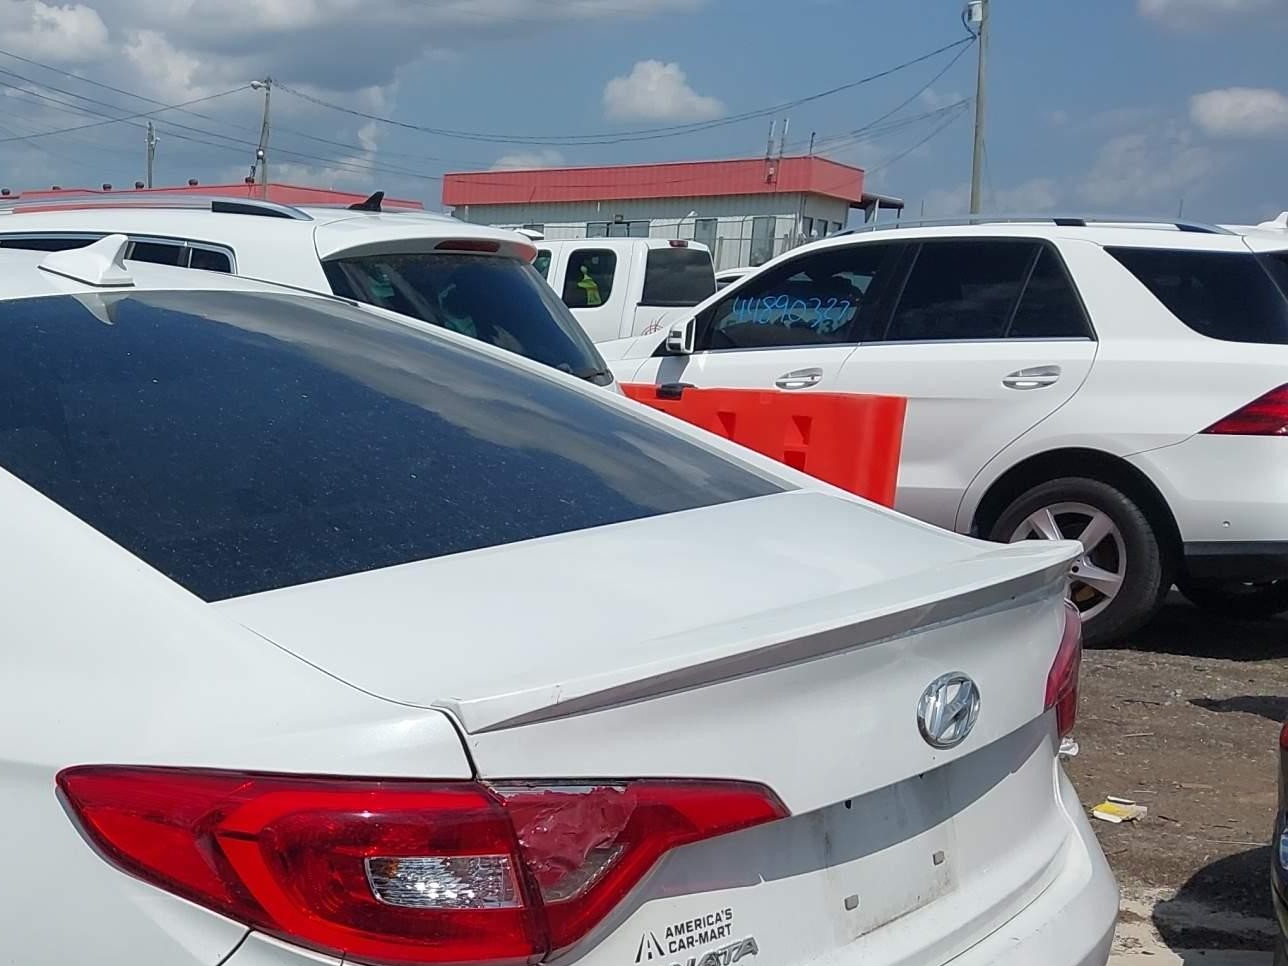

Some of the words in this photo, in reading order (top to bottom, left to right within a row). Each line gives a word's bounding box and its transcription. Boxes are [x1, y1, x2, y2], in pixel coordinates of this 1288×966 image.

[732, 294, 851, 328] 44890327
[665, 908, 733, 939] AMERICA'S
[668, 923, 732, 954] CAR-MART
